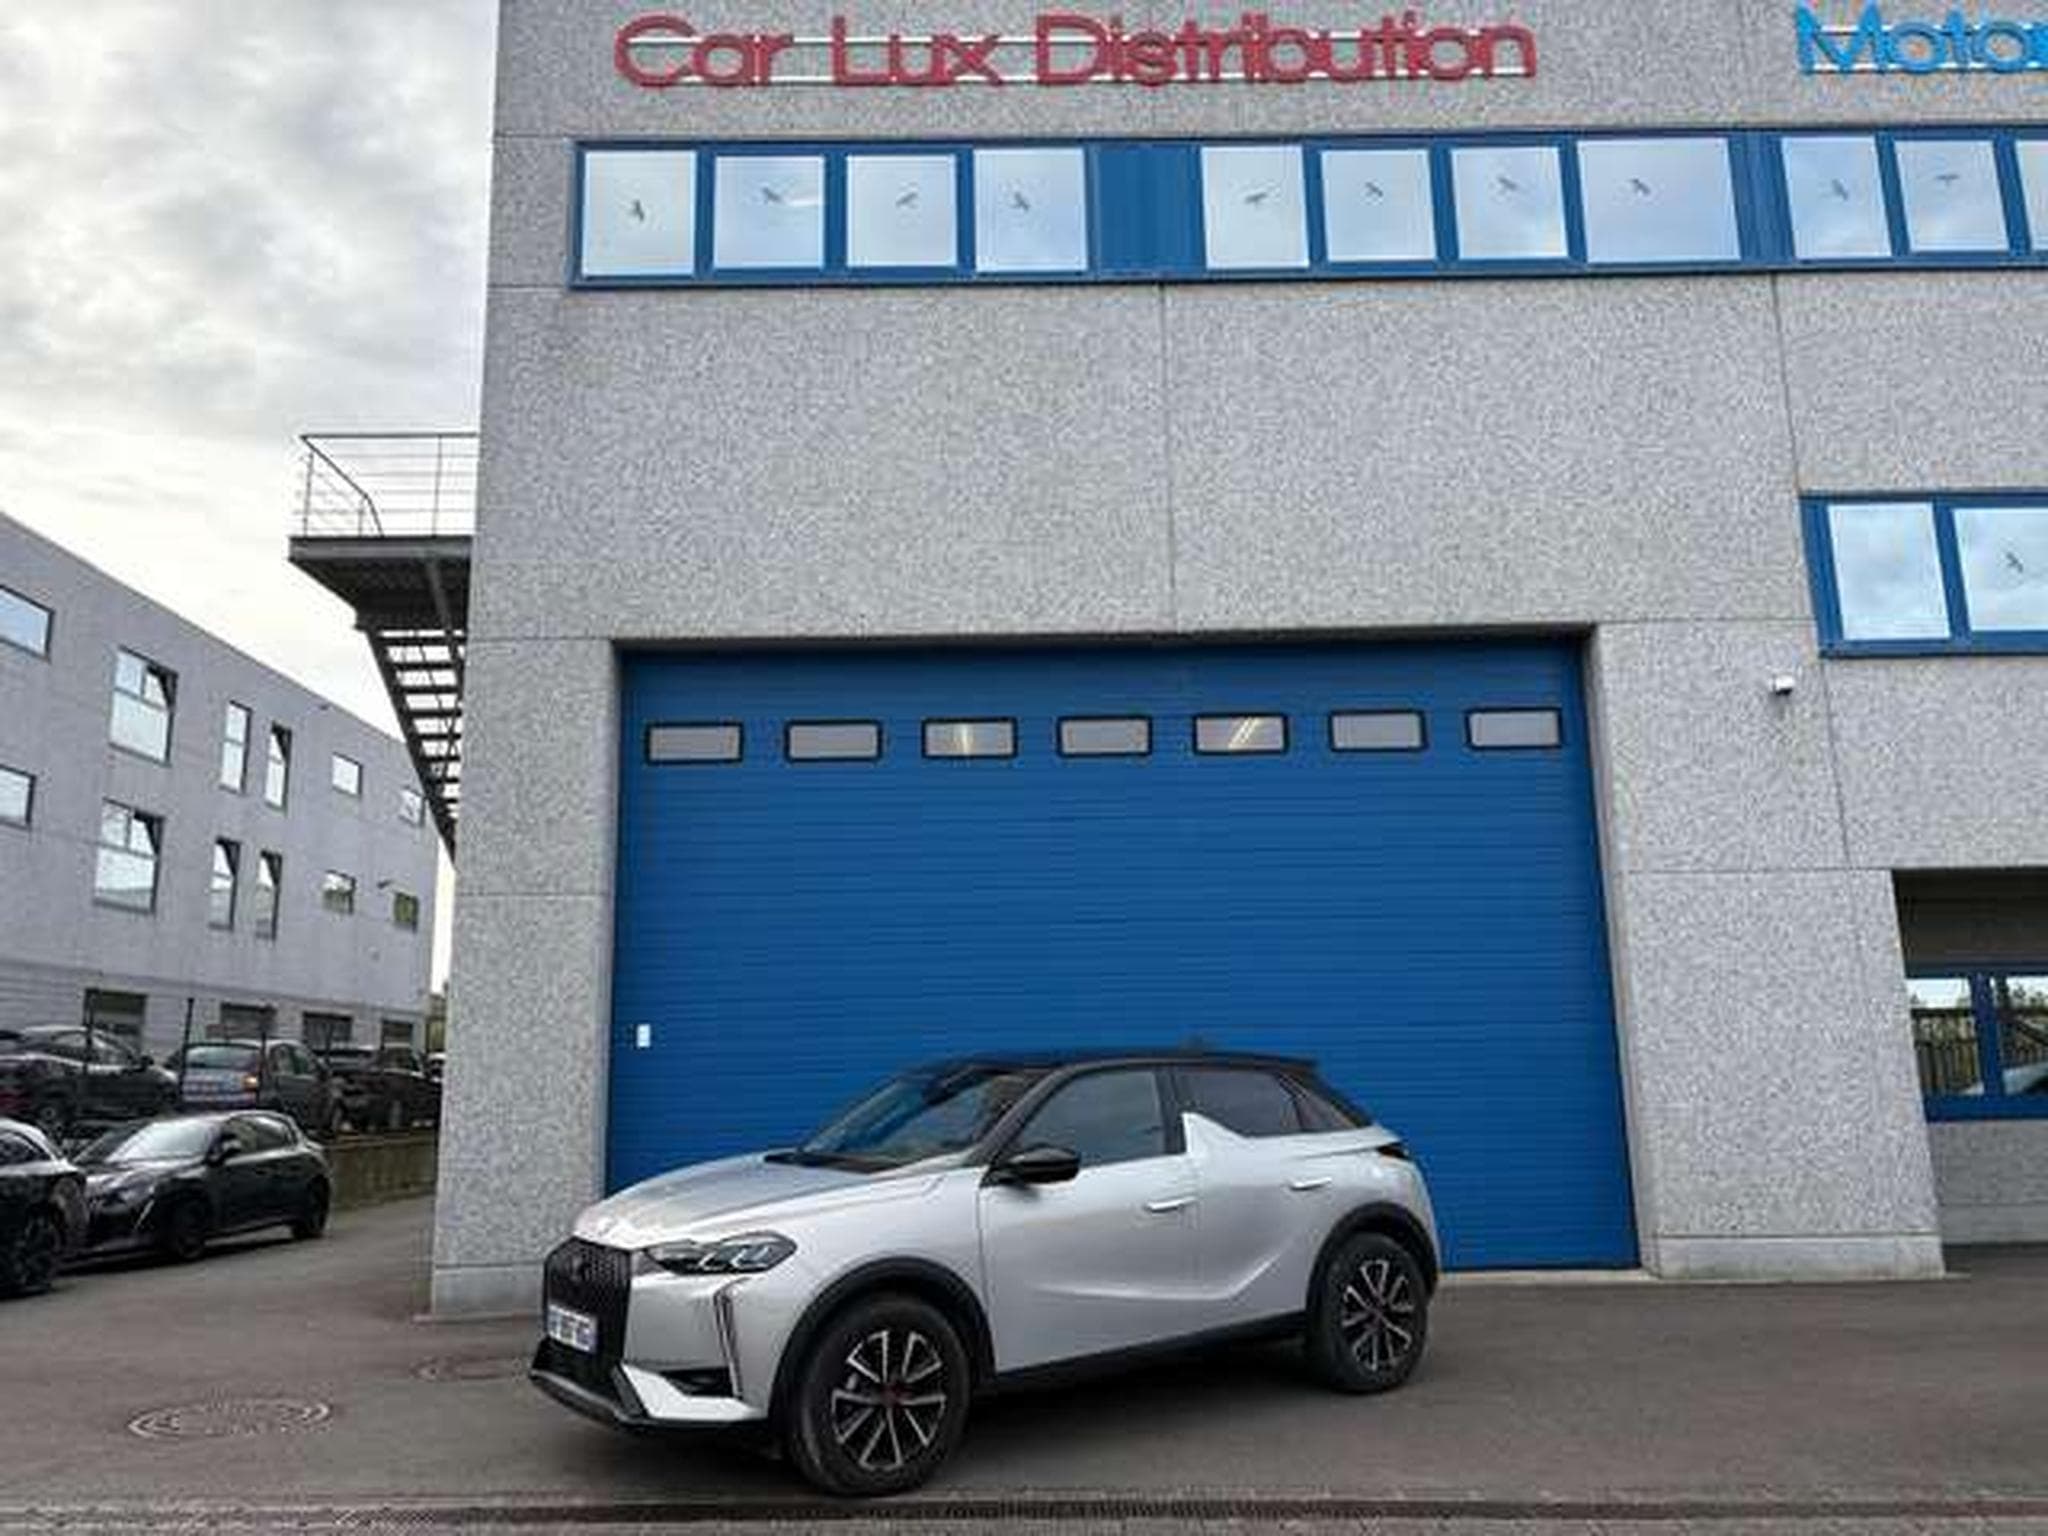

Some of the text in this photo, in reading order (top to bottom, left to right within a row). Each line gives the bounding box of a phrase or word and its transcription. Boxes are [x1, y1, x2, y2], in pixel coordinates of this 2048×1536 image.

[613, 10, 1537, 87] Car Lux Distribution
